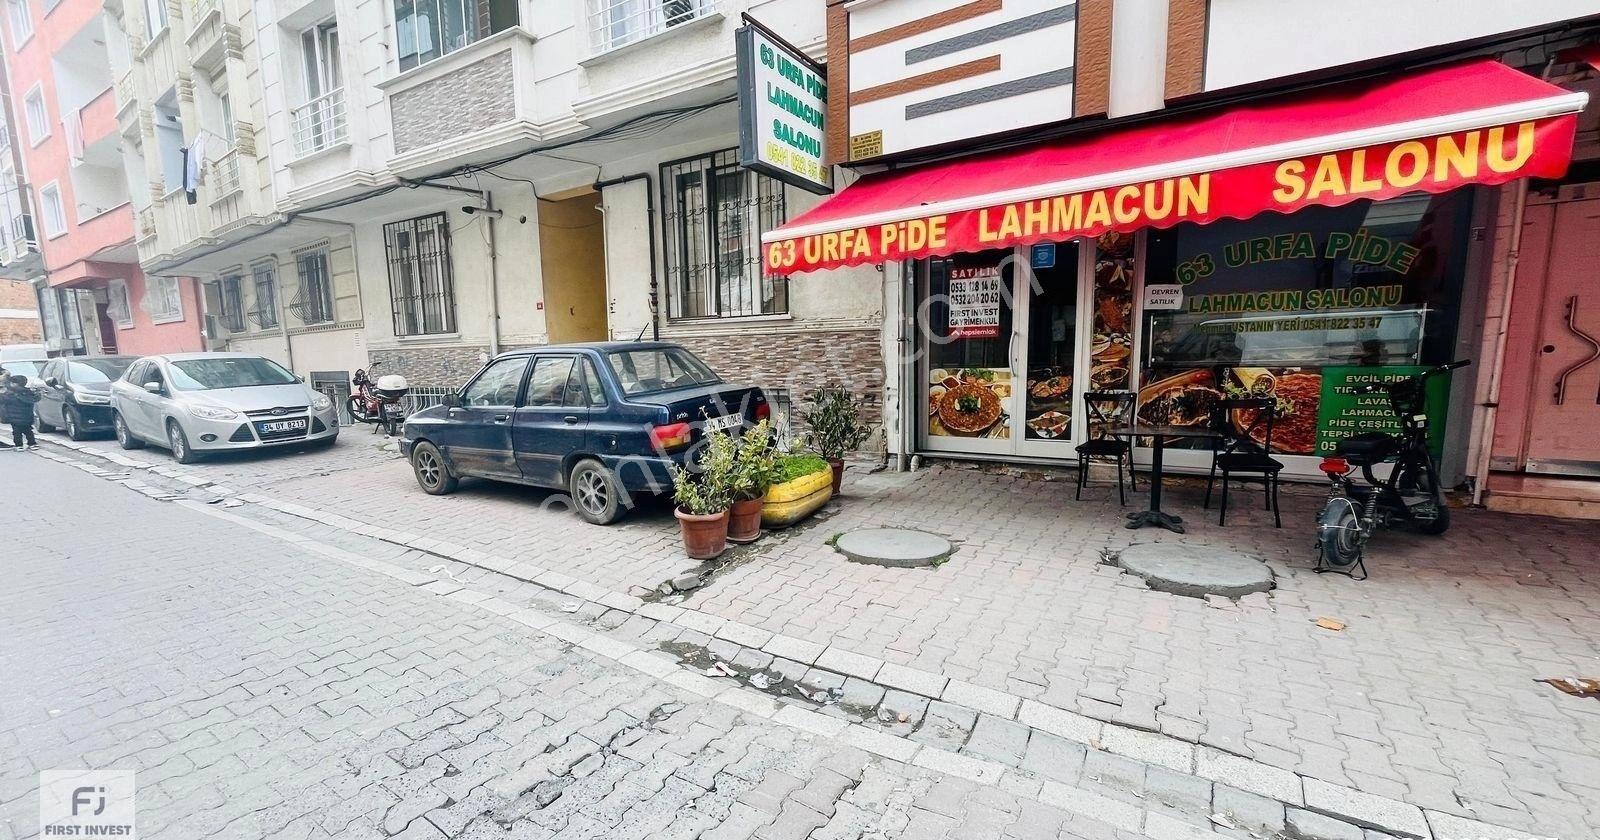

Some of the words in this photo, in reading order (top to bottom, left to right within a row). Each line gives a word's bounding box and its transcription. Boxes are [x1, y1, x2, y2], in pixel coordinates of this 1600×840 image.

[760, 43, 774, 70] 63
[777, 54, 805, 90] URFA
[767, 81, 824, 131] LAHMACUN
[773, 119, 820, 159] SALONU
[769, 241, 796, 269] 63
[803, 230, 871, 264] URFA
[978, 174, 1210, 243] LAHMACUN
[1273, 122, 1536, 204] SALONU
[1176, 253, 1216, 286] 63
[1224, 232, 1317, 268] URFA
[1325, 227, 1421, 276] PİDE
[951, 282, 966, 293] 0533
[951, 294, 966, 305] 0532
[981, 292, 990, 303] 20
[991, 291, 999, 303] 62
[1188, 291, 1304, 315] LAHMACUN
[1306, 285, 1403, 310] SALONU
[972, 308, 998, 316] INVEST
[1232, 321, 1274, 333] USTANIN
[1331, 318, 1350, 329] 822
[1352, 317, 1366, 329] 35
[960, 329, 997, 337] hepsiemlak
[287, 420, 305, 428] 8213
[1329, 419, 1355, 427] PİDE
[1321, 430, 1354, 438] TEPSİ
